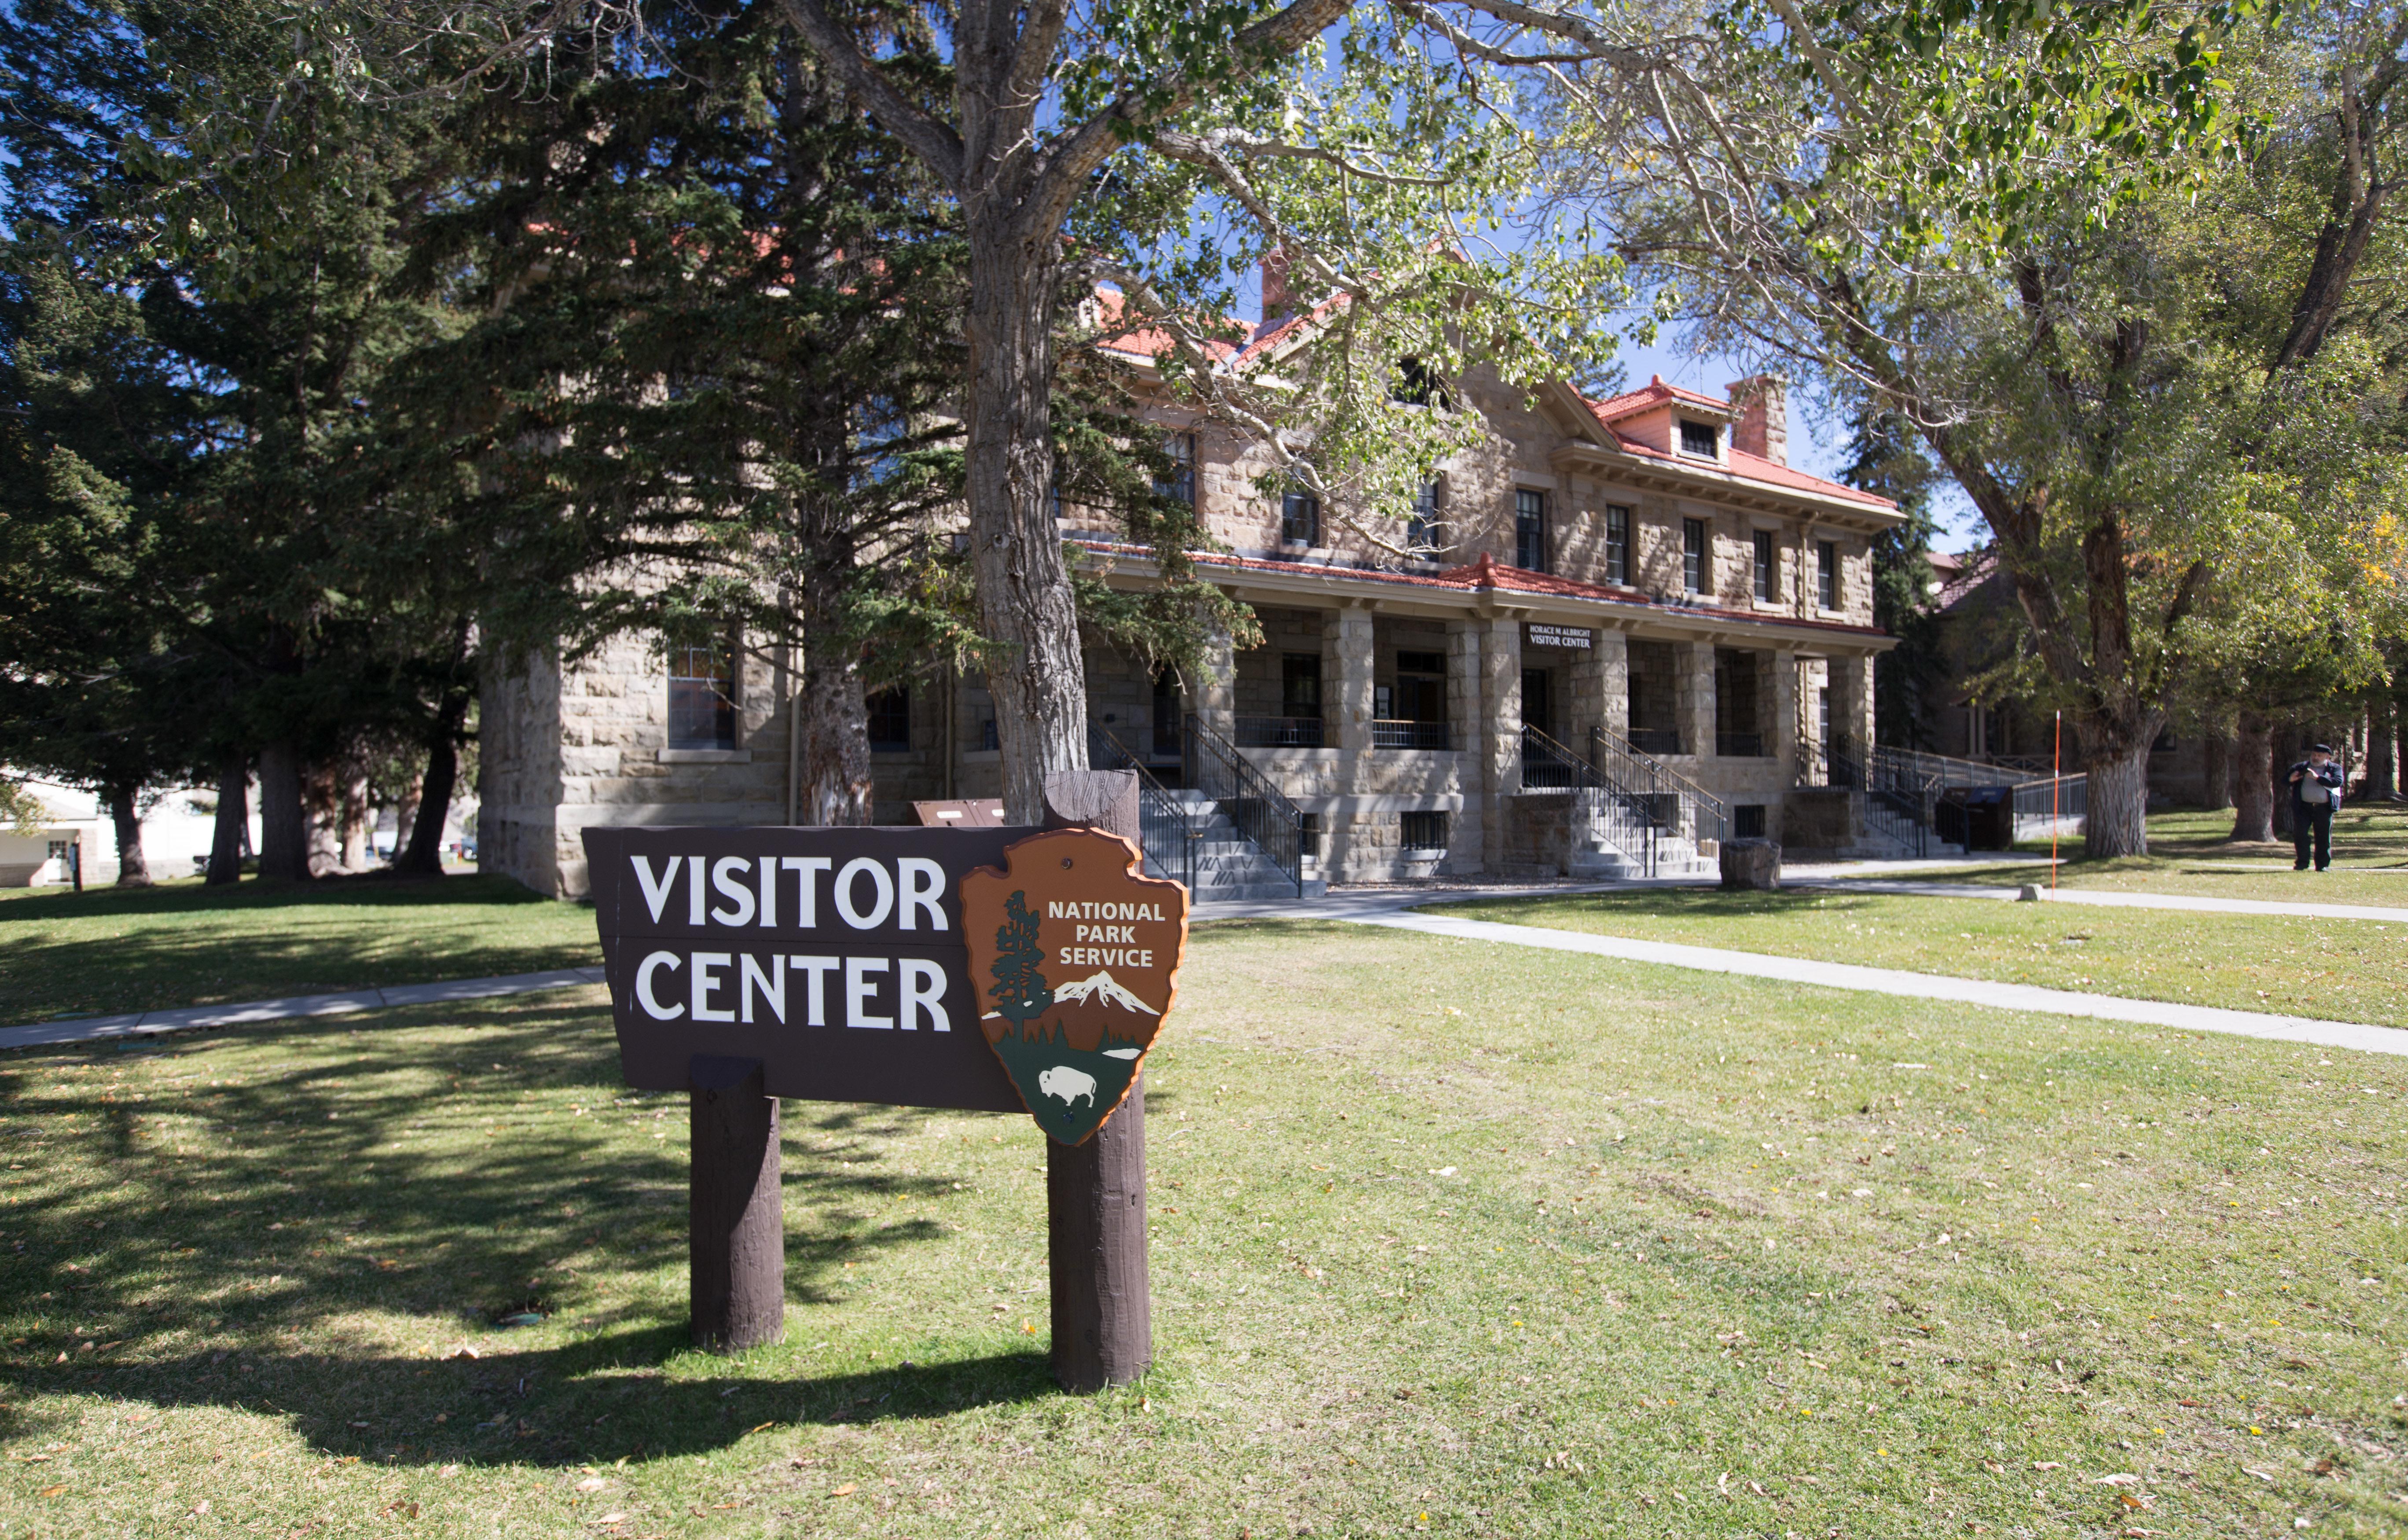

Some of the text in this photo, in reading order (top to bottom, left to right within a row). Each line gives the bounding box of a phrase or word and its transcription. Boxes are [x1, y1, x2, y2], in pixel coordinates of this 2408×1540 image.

[1530, 625, 1554, 634] HORACE
[1562, 627, 1591, 637] ALBRIGHT
[1530, 634, 1590, 648] VISITOR CENTER
[630, 855, 949, 931] VISITOR
[1049, 901, 1166, 921] NATIONAL
[1076, 925, 1136, 943] PARK
[1060, 947, 1153, 967] SERVICE
[635, 951, 951, 1032] CENTER
